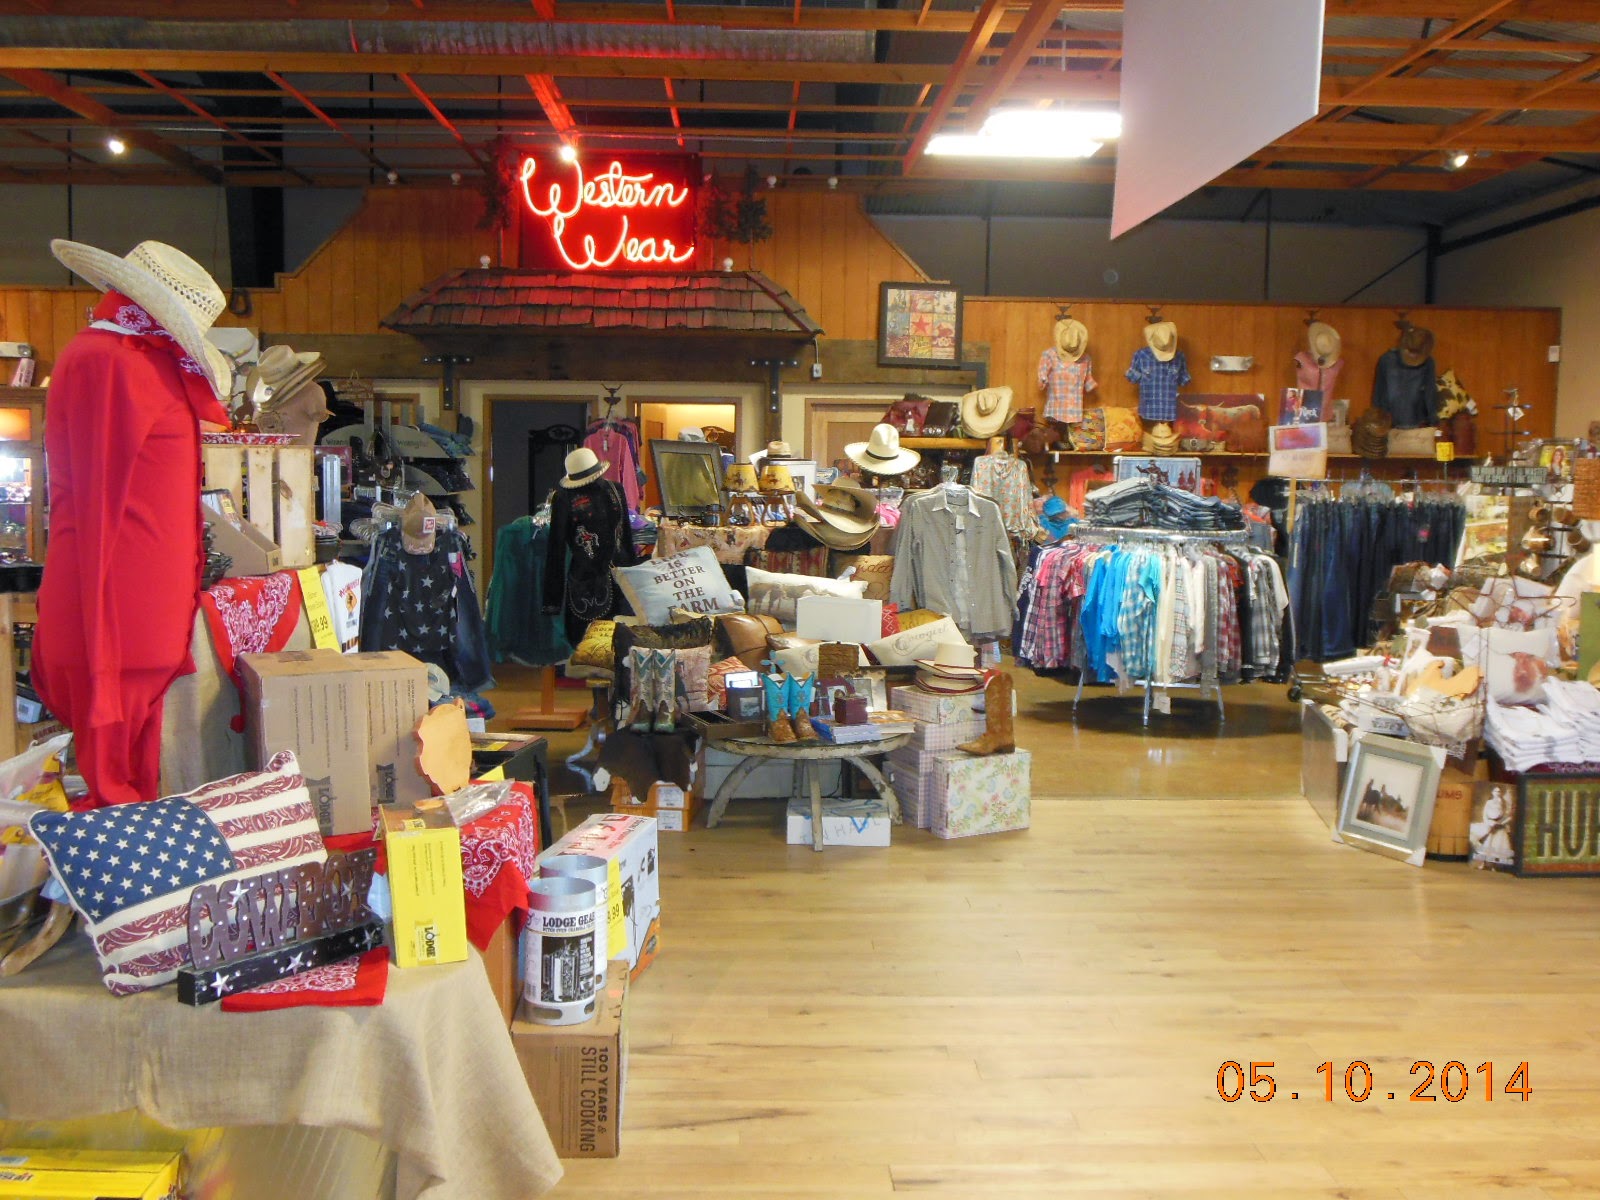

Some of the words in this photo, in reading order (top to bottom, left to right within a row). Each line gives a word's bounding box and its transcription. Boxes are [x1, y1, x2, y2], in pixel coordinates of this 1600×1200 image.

[519, 156, 689, 218] Western
[553, 214, 695, 270] Wear
[653, 565, 706, 585] BETTER
[667, 559, 683, 570] IS
[672, 586, 705, 602] THE
[673, 576, 696, 589] ON
[542, 916, 577, 928] LODGE
[424, 926, 436, 958] LODGE
[581, 1046, 597, 1085] STILL
[598, 1046, 609, 1073] 100
[597, 1077, 608, 1123] YEARS
[580, 1089, 597, 1152] COOKING
